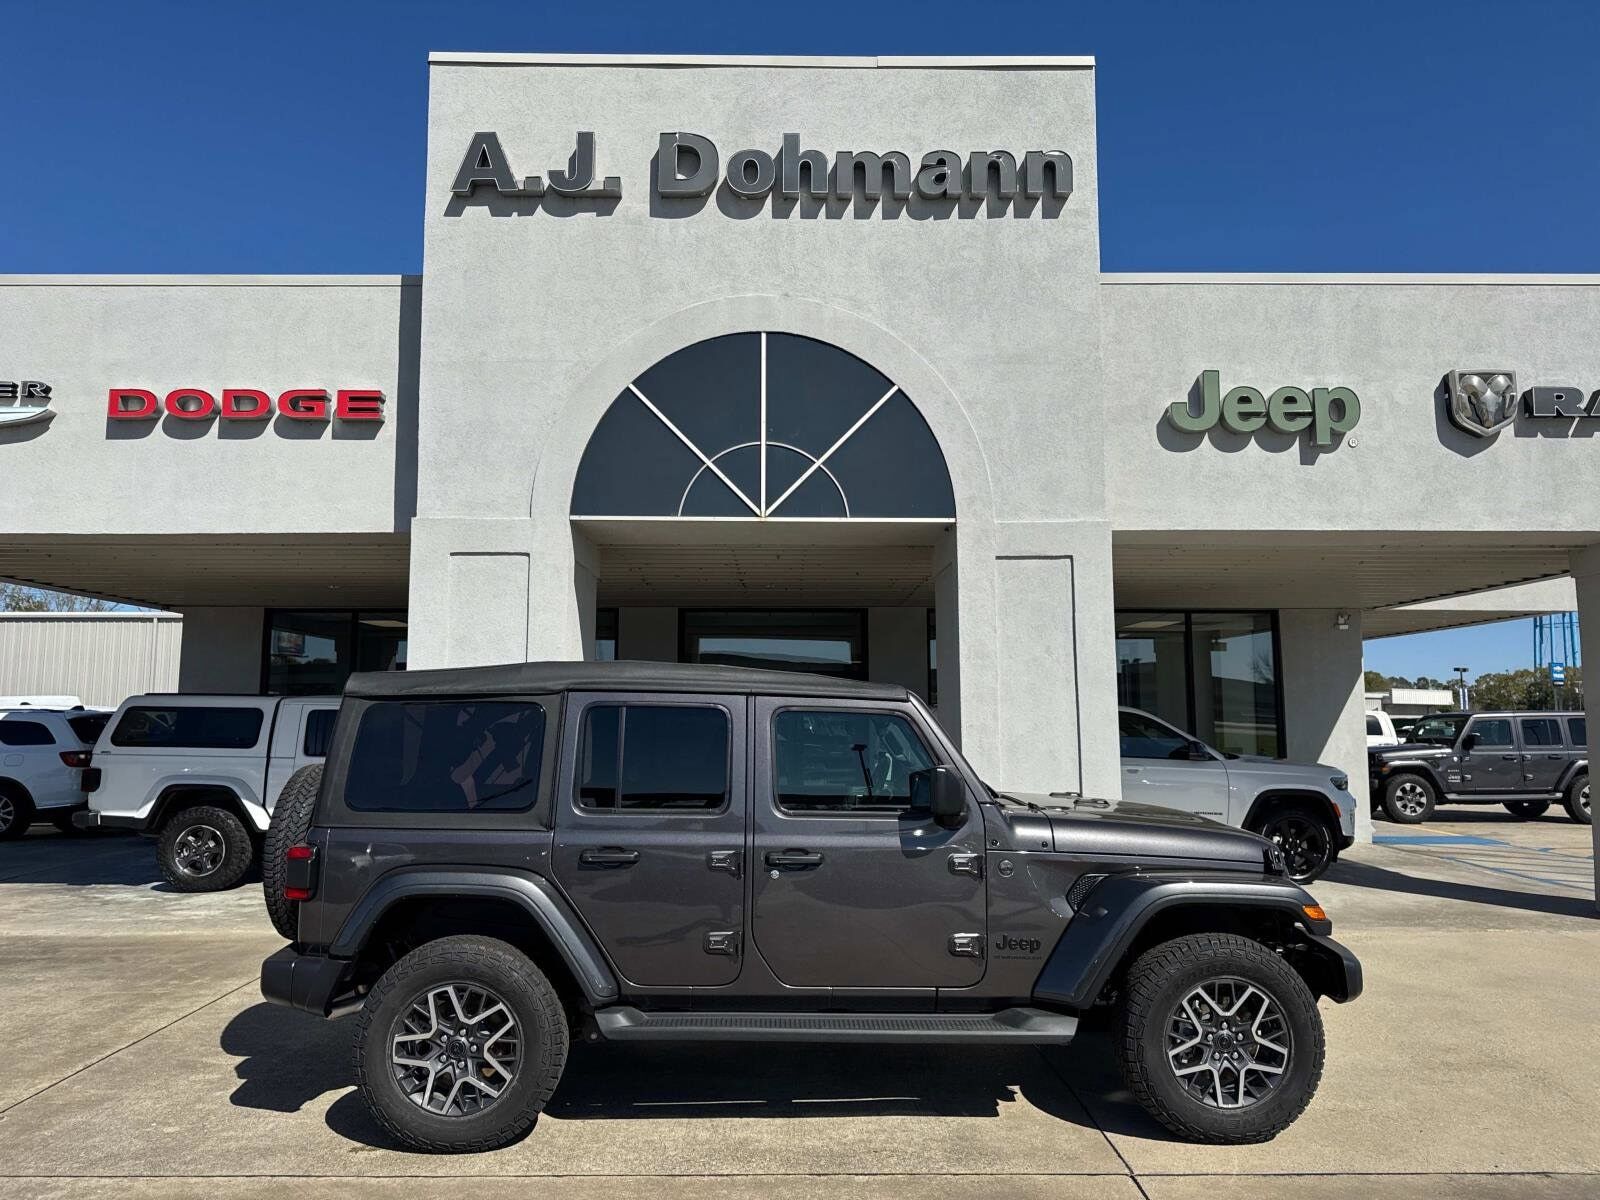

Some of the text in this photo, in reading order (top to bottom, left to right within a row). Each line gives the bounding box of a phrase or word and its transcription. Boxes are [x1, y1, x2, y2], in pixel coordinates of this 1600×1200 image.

[450, 131, 1074, 199] A.J. Dohmann
[108, 388, 386, 421] DODGE
[1166, 369, 1361, 447] Jeep
[995, 933, 1041, 954] Jeep
